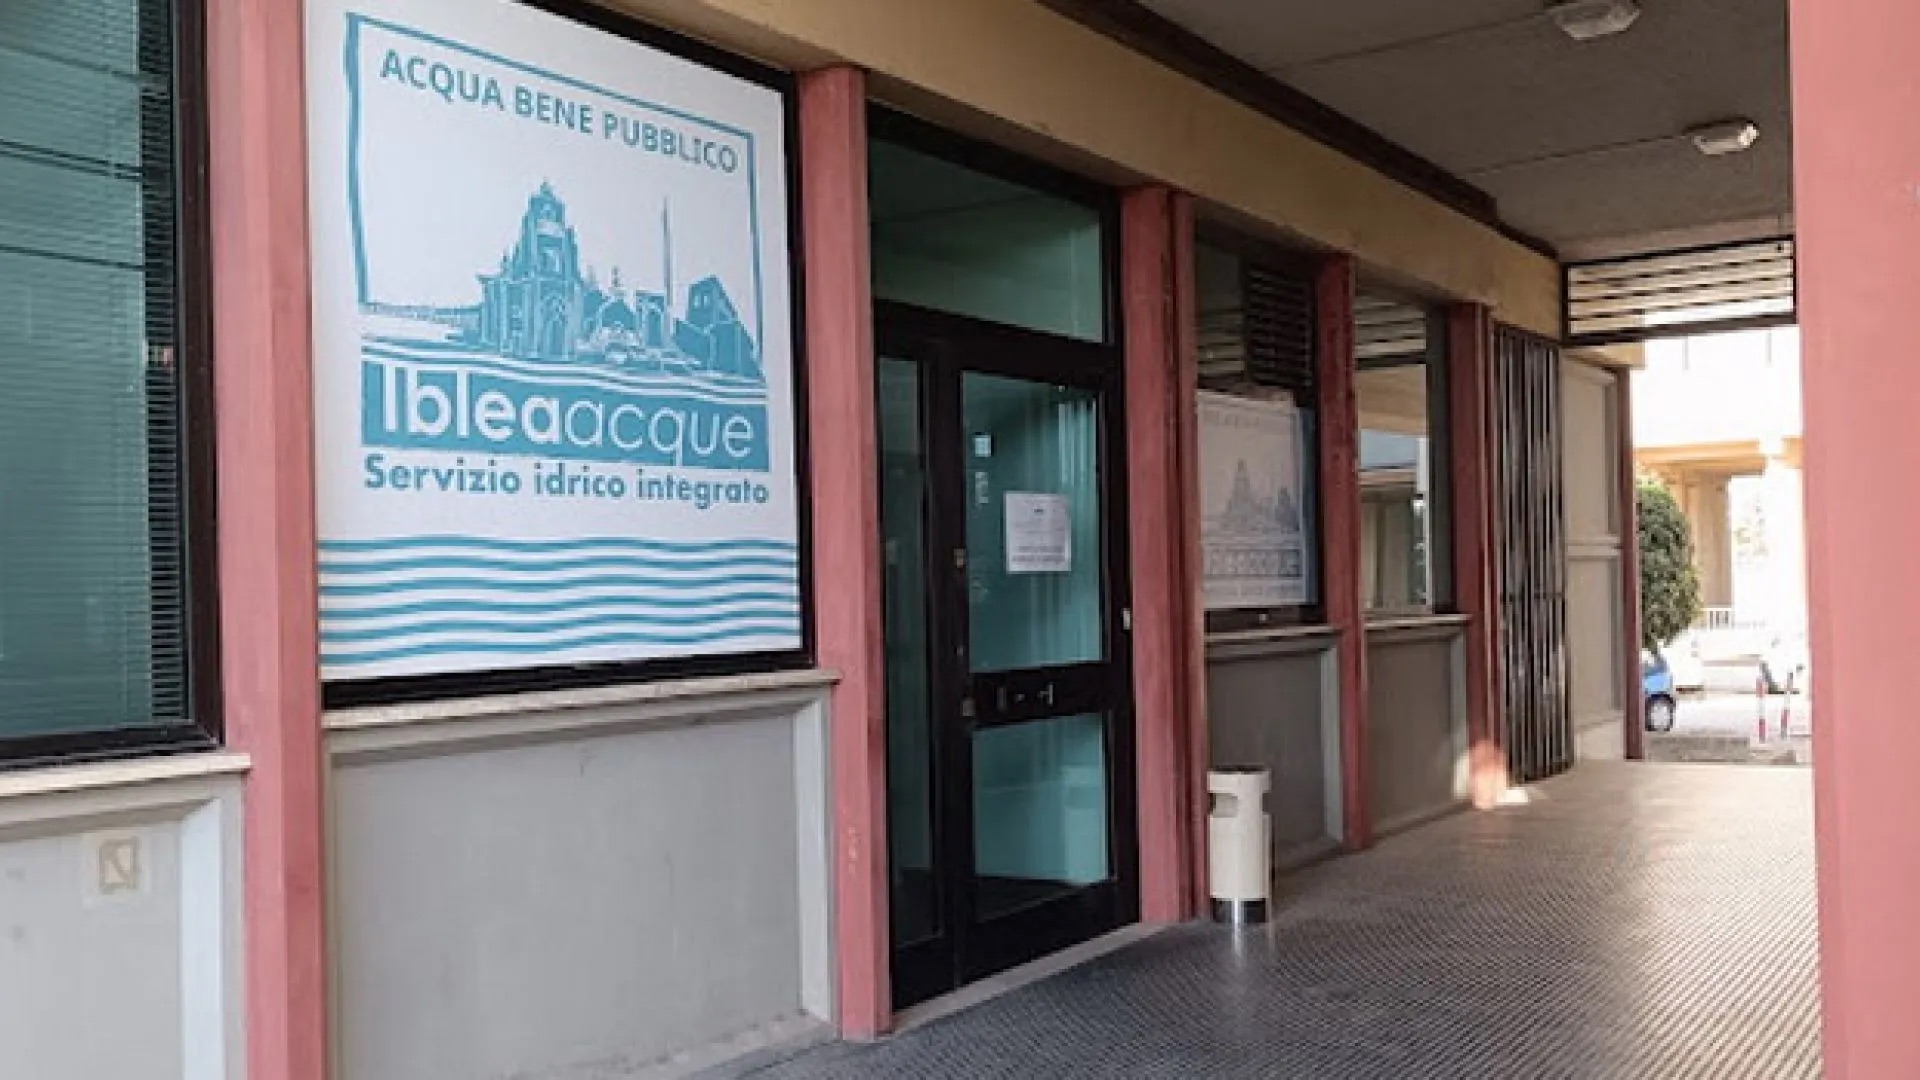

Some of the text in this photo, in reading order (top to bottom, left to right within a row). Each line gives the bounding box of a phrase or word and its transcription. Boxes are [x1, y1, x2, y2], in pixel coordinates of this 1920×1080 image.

[380, 48, 739, 174] ACQUA BENE PUBBLICO
[382, 364, 755, 467] Ibleaacque
[363, 453, 770, 511] Servizio idrico integrato
